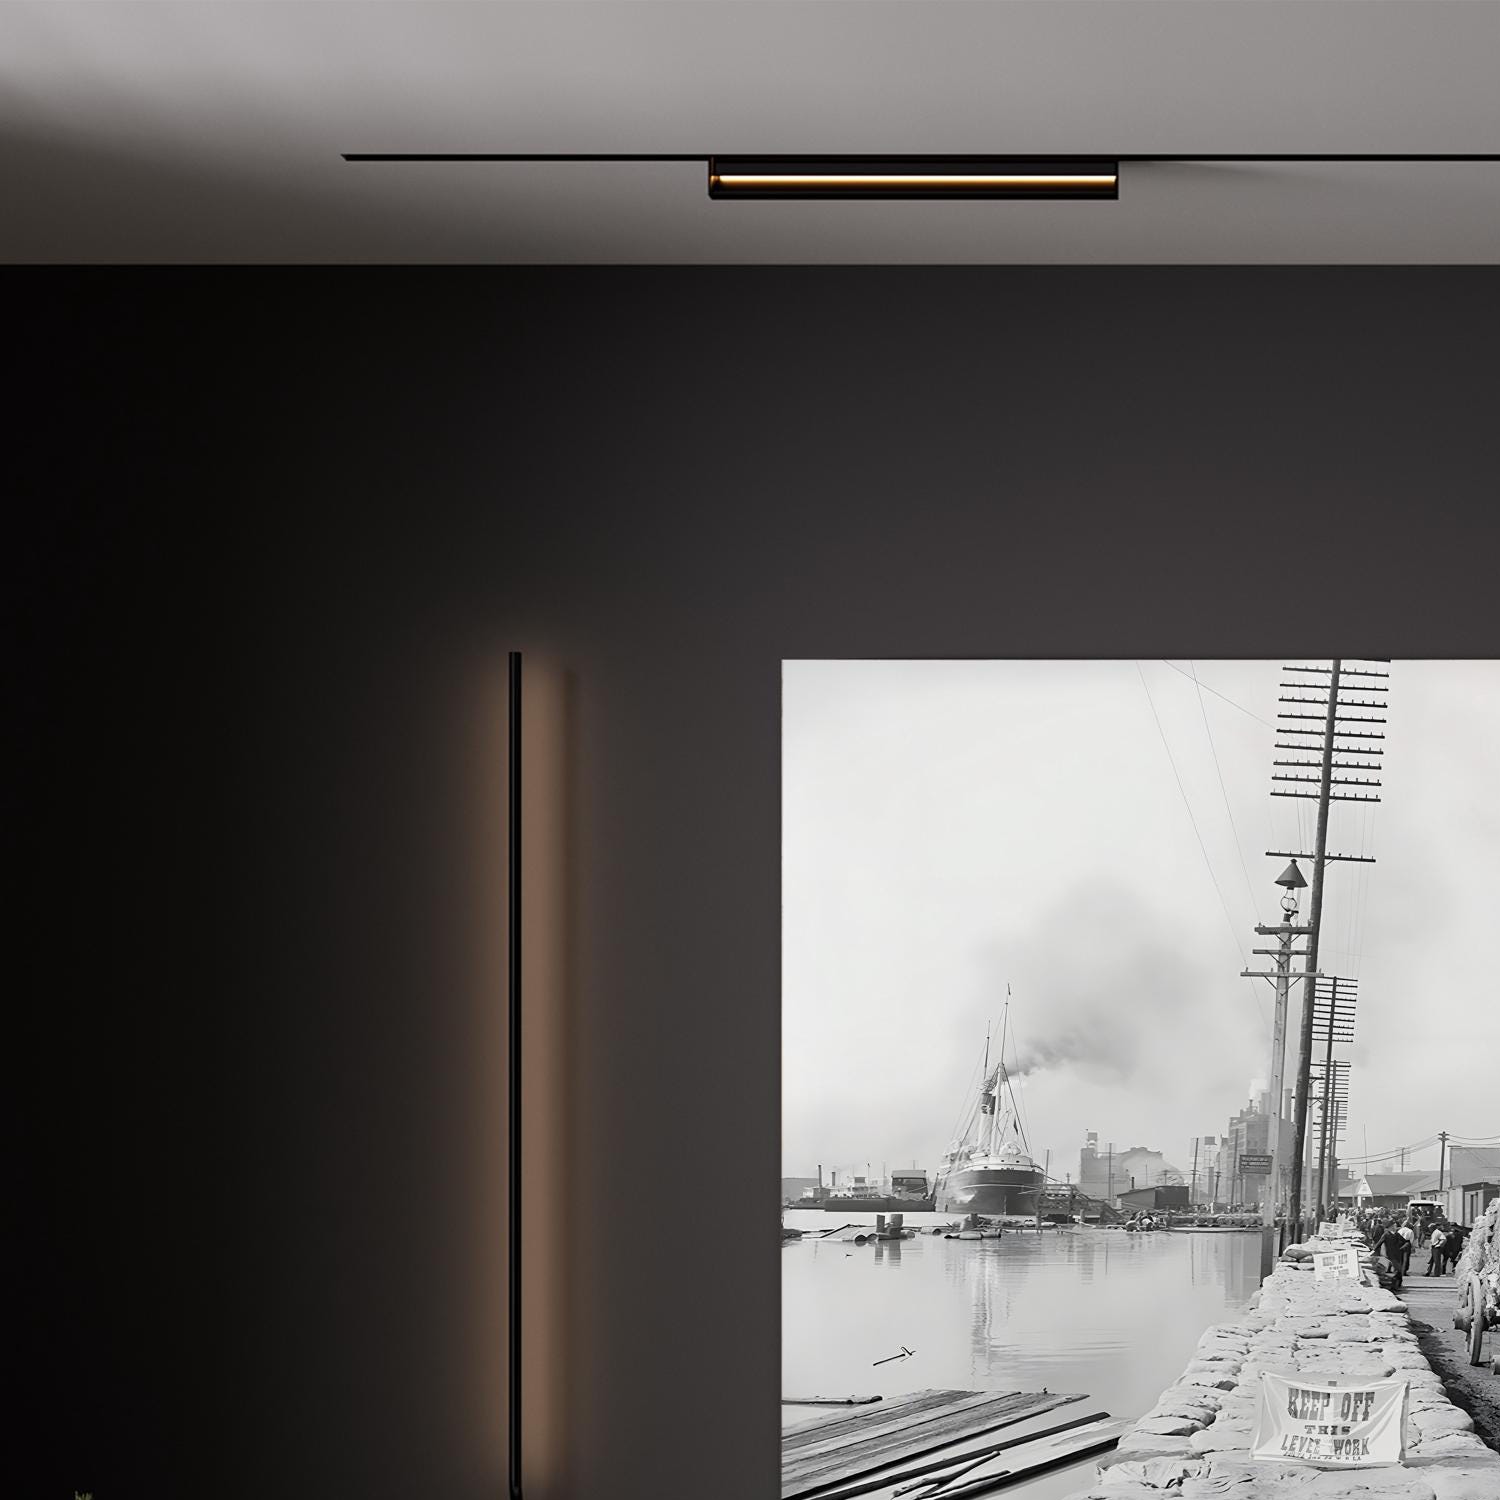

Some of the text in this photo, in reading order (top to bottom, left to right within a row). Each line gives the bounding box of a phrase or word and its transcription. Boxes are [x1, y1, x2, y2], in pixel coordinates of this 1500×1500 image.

[1287, 1387, 1375, 1421] KEEP OFF
[1304, 1425, 1351, 1435] THIS
[1333, 1438, 1370, 1456] WORK
